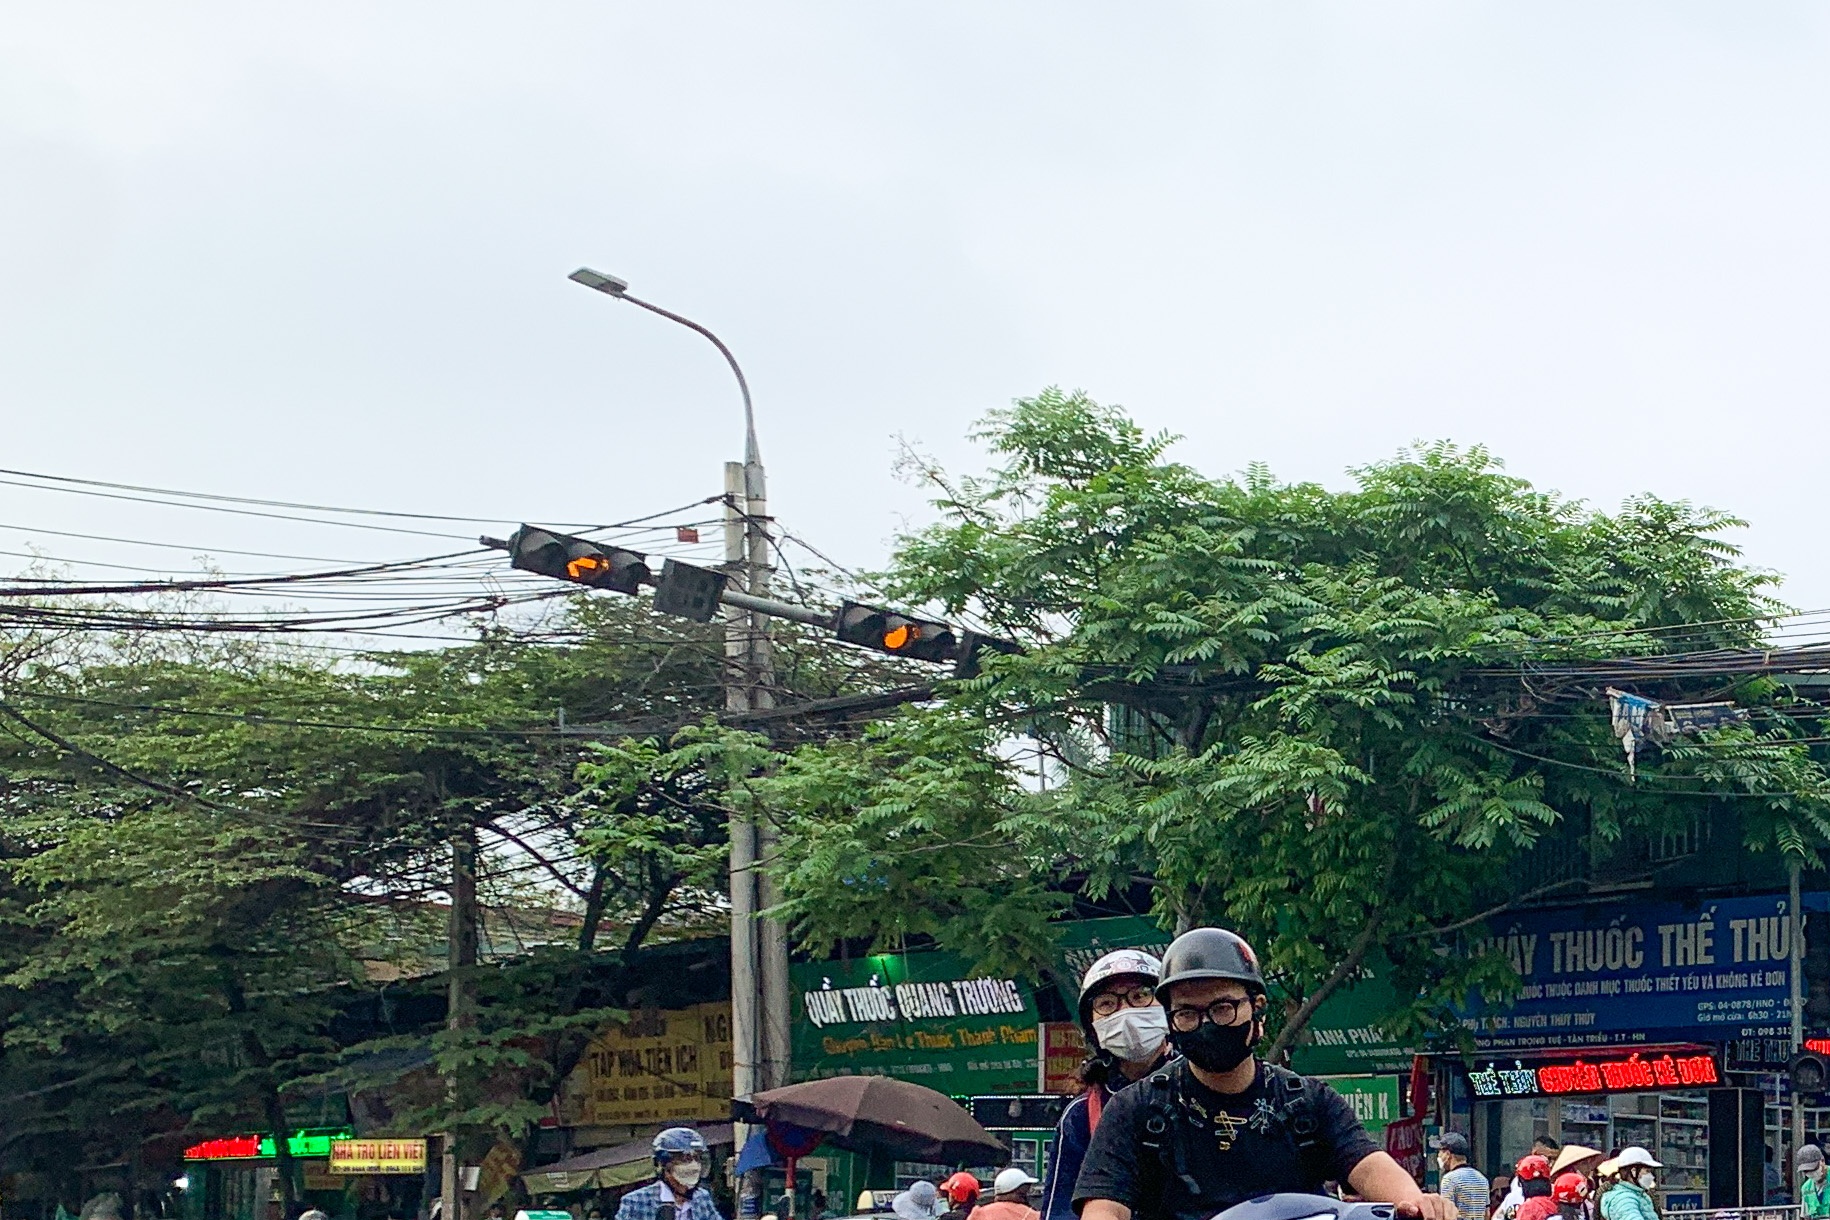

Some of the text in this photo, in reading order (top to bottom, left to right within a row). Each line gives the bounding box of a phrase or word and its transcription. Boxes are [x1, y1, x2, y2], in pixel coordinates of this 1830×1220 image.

[1549, 913, 1645, 975] THUỐC
[1657, 904, 1716, 968] THẾ
[804, 976, 847, 1029] QUẦY
[843, 973, 897, 1023] THUỐC
[894, 980, 956, 1023] QUANG
[1378, 1092, 1389, 1120] K
